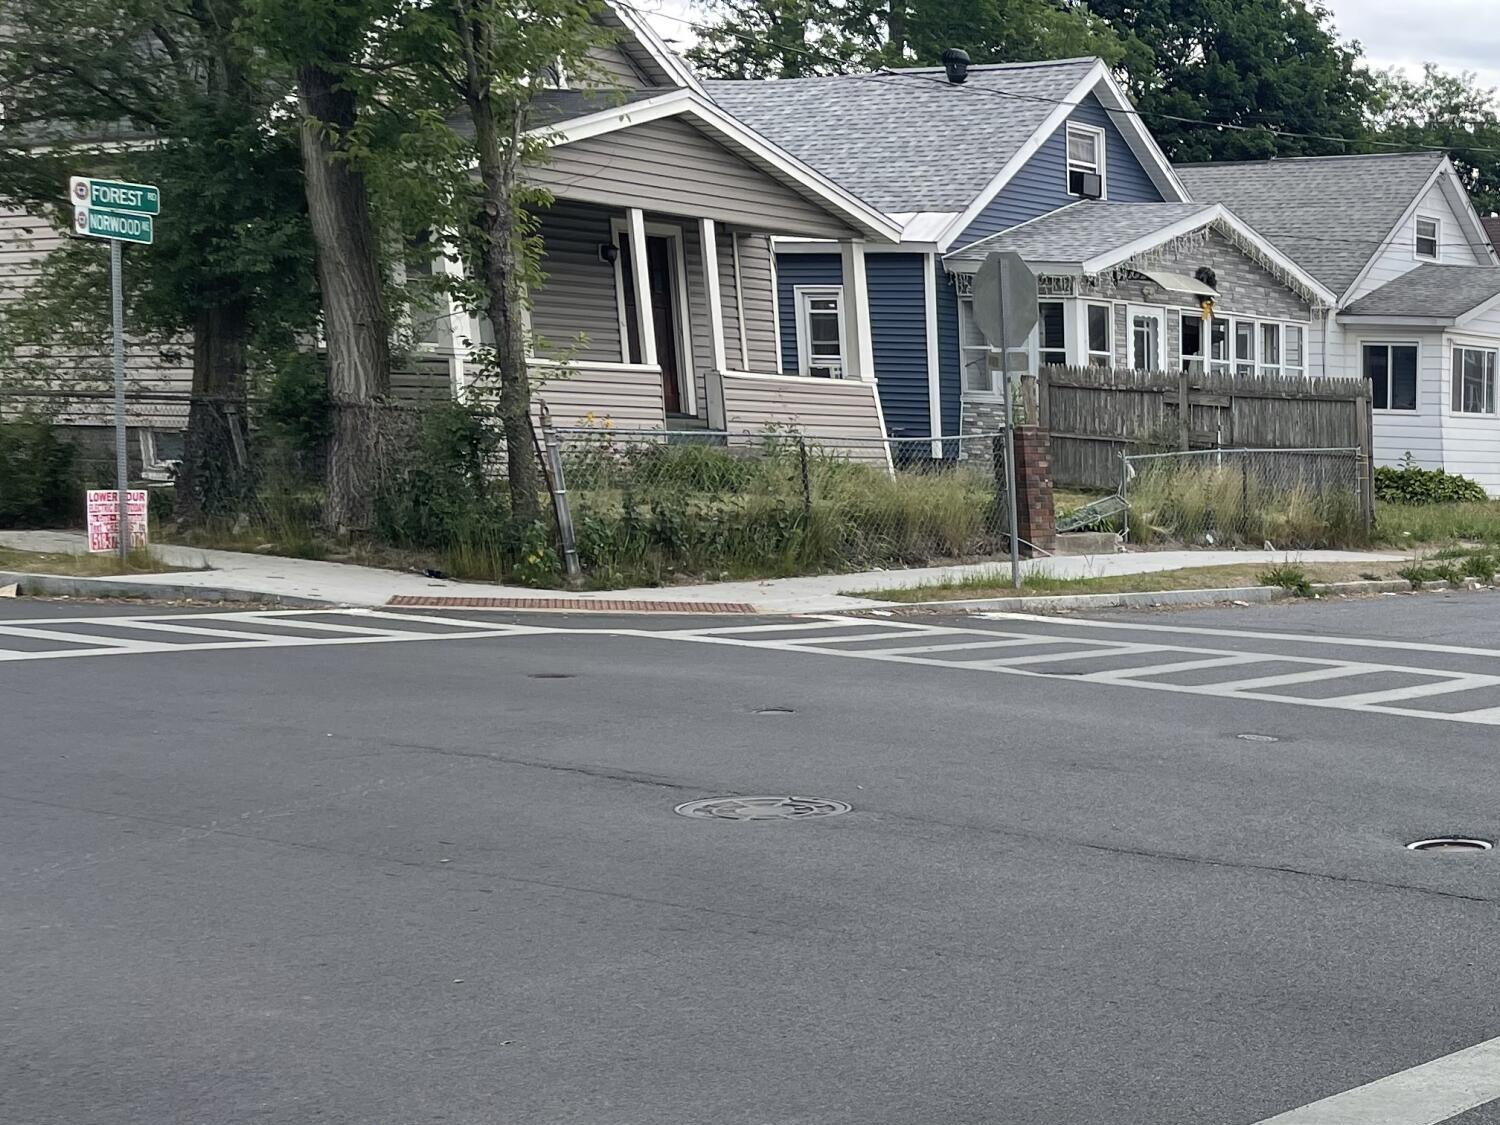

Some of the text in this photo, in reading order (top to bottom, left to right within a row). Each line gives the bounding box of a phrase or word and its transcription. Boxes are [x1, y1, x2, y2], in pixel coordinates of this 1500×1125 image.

[92, 185, 157, 206] FOREST RD
[89, 214, 140, 235] NORWOOD
[89, 492, 145, 502] LOWER OUR
